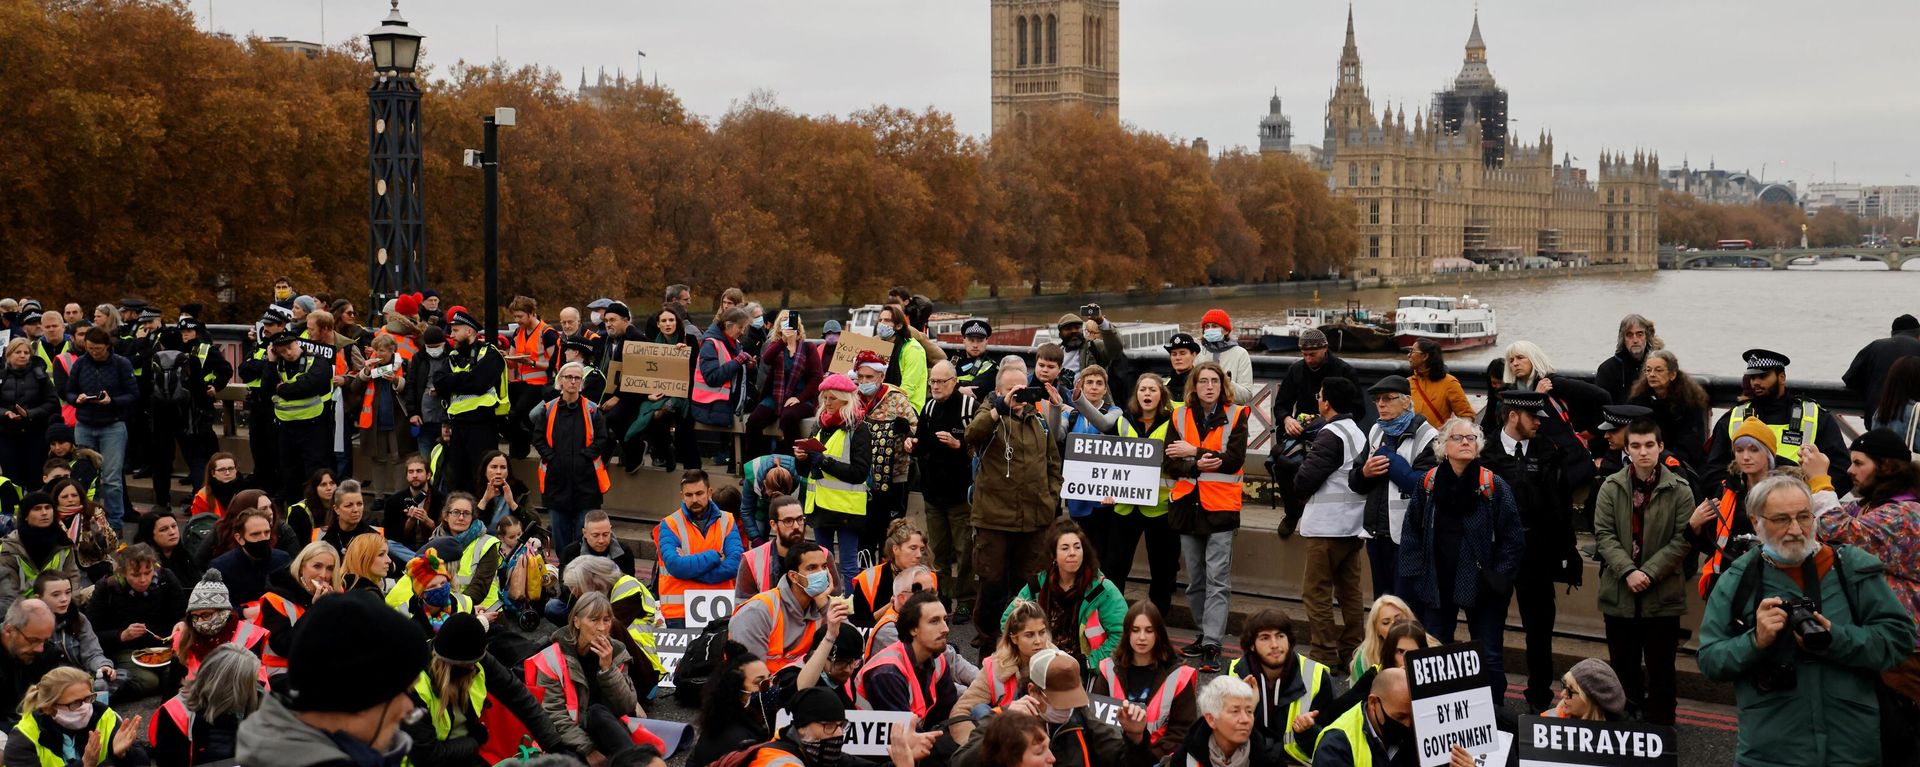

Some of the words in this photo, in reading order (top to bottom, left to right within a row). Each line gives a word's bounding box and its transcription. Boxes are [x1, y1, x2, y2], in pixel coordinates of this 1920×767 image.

[625, 343, 658, 356] CLIMATE
[661, 346, 690, 358] JUSTICE
[646, 361, 658, 372] IS
[624, 377, 652, 389] SOCIAL
[653, 380, 688, 392] JUSTICE
[1073, 438, 1154, 459] BETRAYED
[1091, 467, 1108, 480] BY
[1112, 469, 1131, 481] MY
[1067, 482, 1153, 500] GOVERNMENT
[1413, 650, 1481, 686] BETRAYED
[1437, 703, 1450, 724] BY
[1454, 699, 1469, 721] MY
[844, 721, 893, 745] AYE
[1423, 724, 1493, 758] GOVERNMENT
[1533, 723, 1663, 758] BETRAYED
